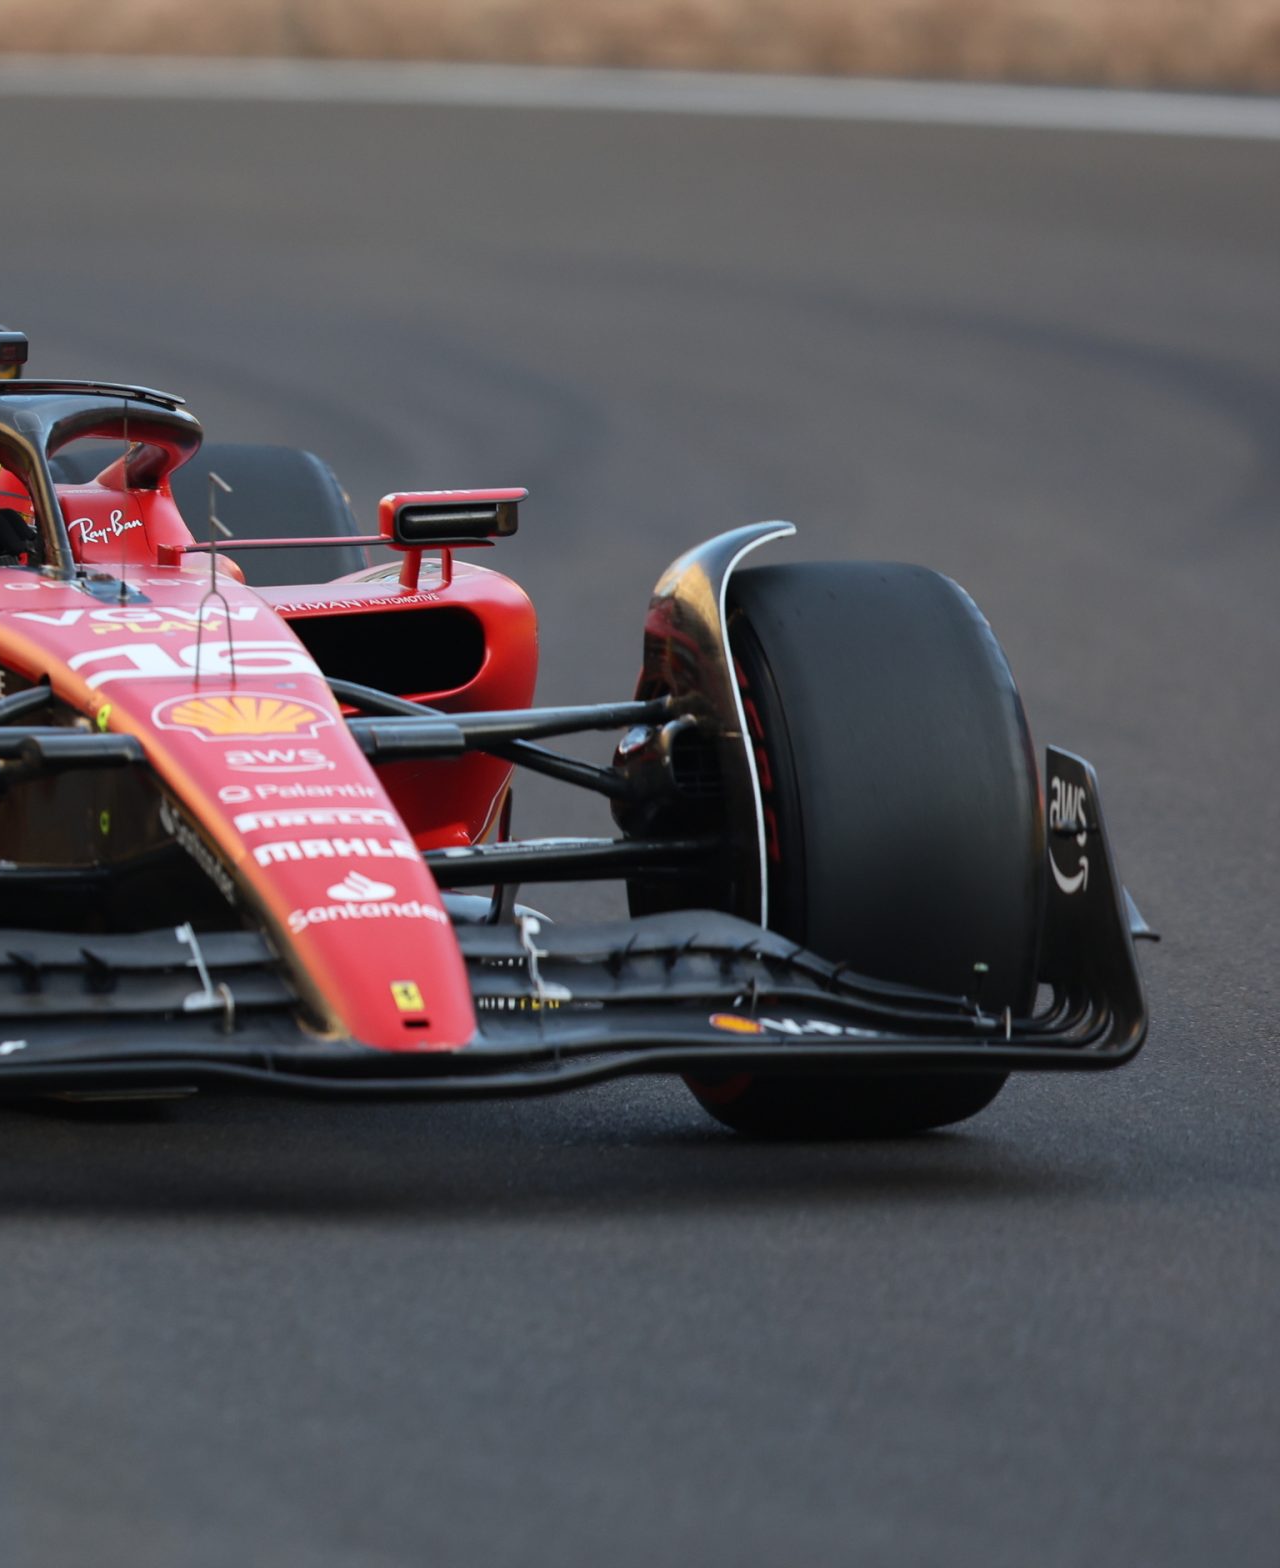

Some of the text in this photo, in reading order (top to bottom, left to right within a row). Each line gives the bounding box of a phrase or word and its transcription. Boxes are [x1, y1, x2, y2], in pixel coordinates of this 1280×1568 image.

[66, 509, 144, 544] Ray-Ban
[11, 605, 259, 628] VGW
[272, 592, 440, 613] ARMAN AUTOMOTIVE
[89, 619, 224, 635] PLAY
[67, 640, 326, 690] 16
[224, 748, 326, 768] aws
[254, 783, 377, 801] Palantir
[233, 806, 398, 835] PIRELLI
[1049, 775, 1087, 847] aws
[253, 838, 422, 868] MAHLE
[287, 901, 450, 935] Santander
